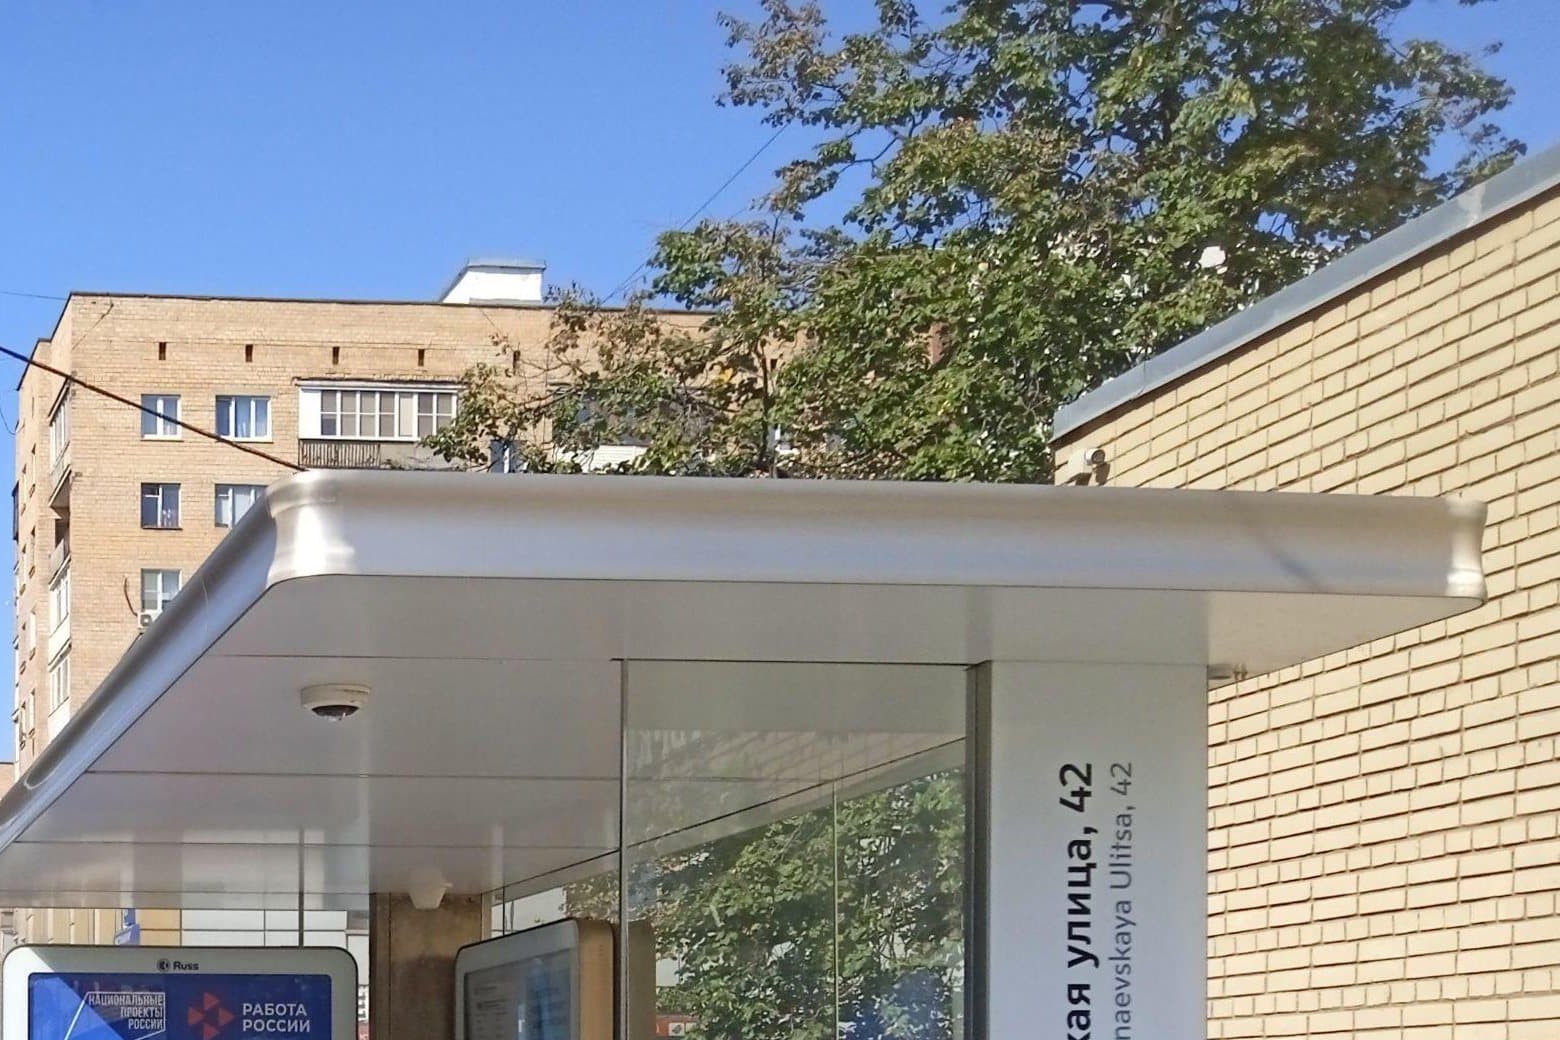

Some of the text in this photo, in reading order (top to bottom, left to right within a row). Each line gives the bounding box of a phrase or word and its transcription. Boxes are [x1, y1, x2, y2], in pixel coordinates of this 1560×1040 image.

[1110, 762, 1132, 796] 42
[1059, 763, 1092, 813] 42
[1108, 805, 1136, 889] Ulitsa,
[1067, 827, 1099, 969] улица,
[173, 960, 200, 971] Russ
[89, 994, 164, 1006] НАЦИОНАЛЬНЫЕ
[120, 1007, 163, 1017] ПРОЕКТЫ
[242, 1003, 307, 1016] РАБОТА
[128, 1018, 163, 1030] РОССИИ
[242, 1019, 311, 1033] РОССИИ
